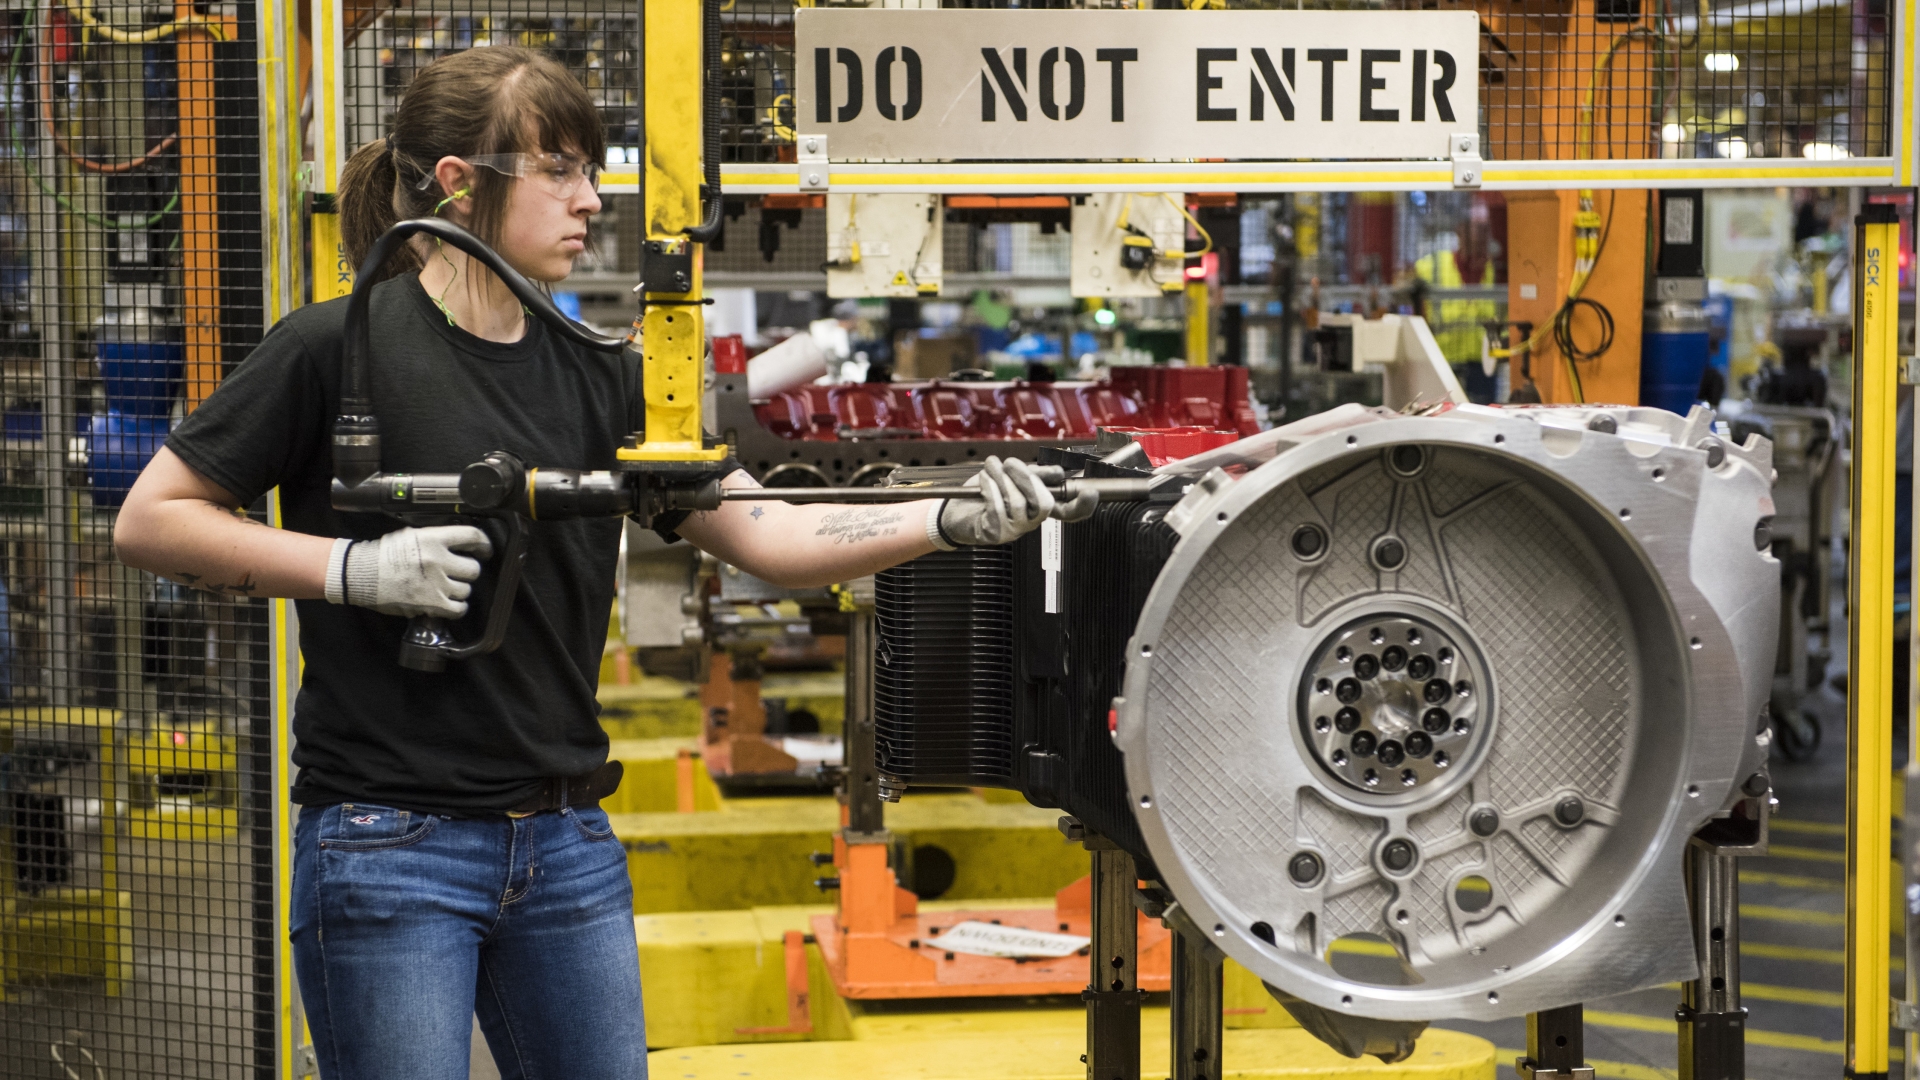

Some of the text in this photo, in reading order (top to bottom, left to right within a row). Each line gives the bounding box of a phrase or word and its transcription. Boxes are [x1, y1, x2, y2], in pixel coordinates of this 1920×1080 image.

[814, 46, 1456, 122] DO NOT ENTER
[1867, 248, 1880, 286] SICK
